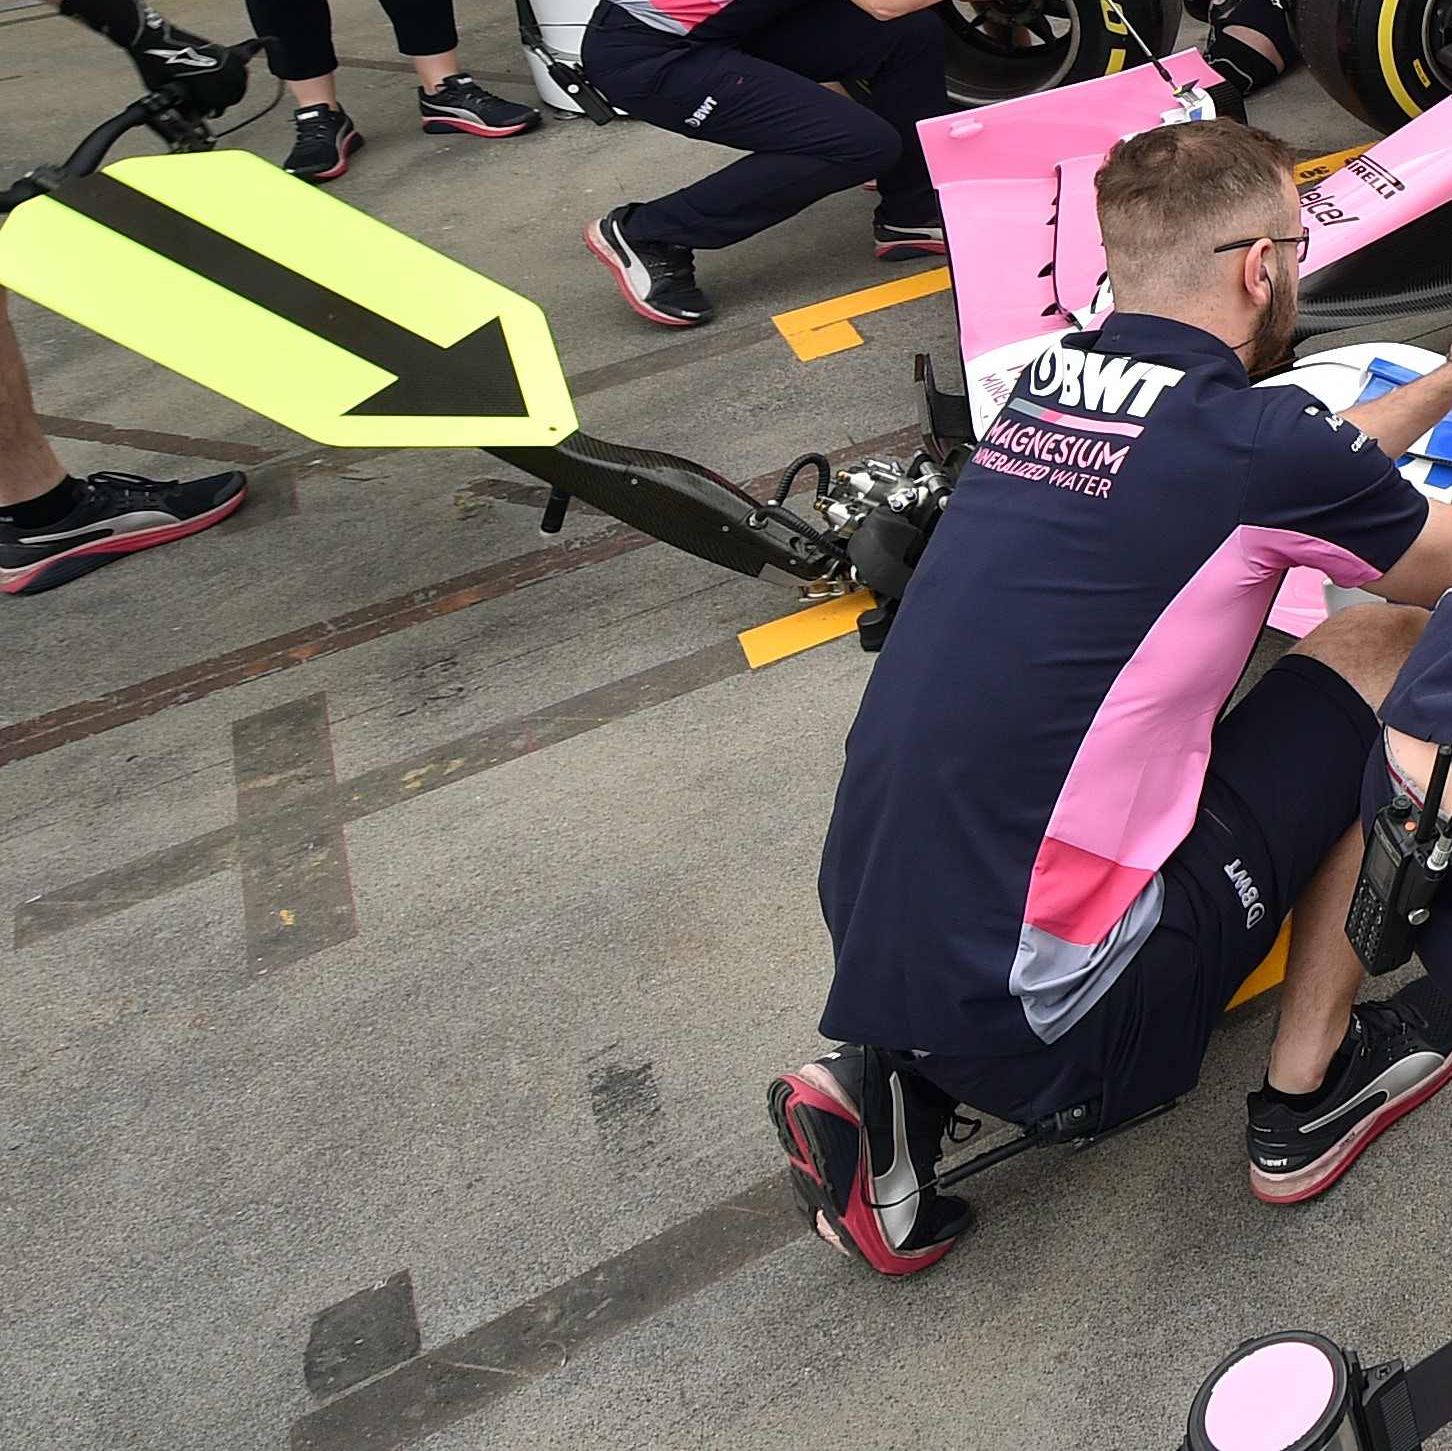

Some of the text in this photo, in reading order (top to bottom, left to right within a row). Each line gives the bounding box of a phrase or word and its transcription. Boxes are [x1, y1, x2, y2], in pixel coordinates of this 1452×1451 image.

[1058, 347, 1186, 419] BWT
[971, 445, 1113, 499] MINERALIZED WATER
[985, 414, 1131, 475] MAGNESIUM
